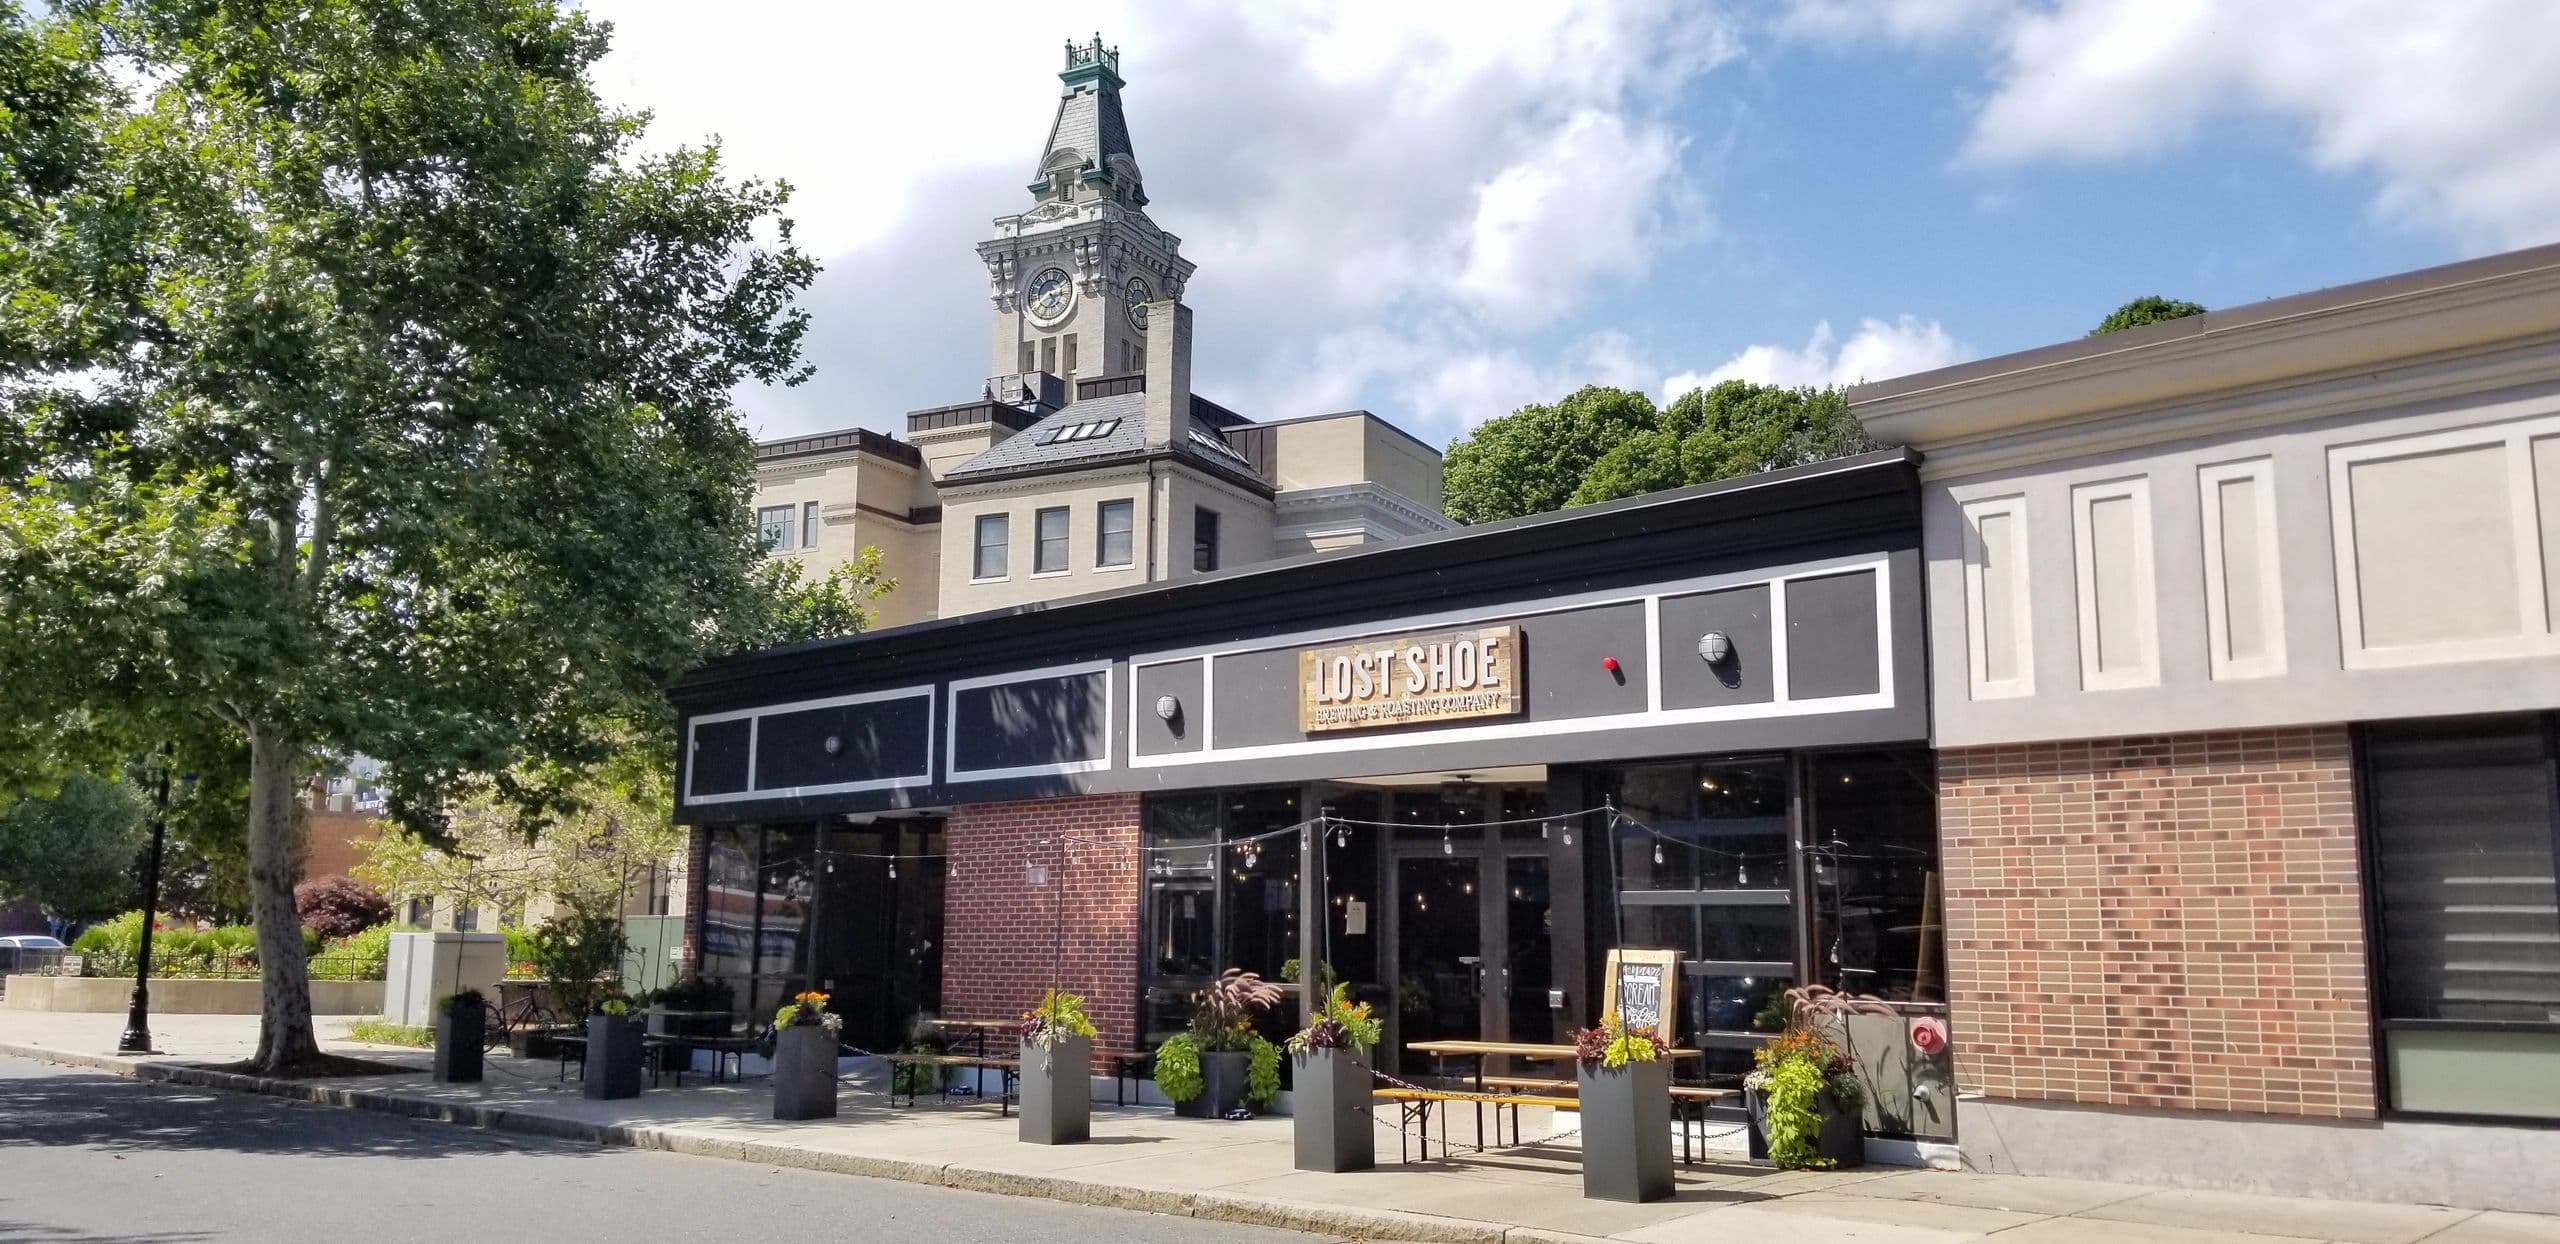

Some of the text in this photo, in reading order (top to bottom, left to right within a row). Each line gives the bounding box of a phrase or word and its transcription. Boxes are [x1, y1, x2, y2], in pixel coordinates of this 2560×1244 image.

[1315, 638, 1499, 702] LOST SHOE
[1316, 692, 1500, 723] BREWING & ROASTING COMPANY
